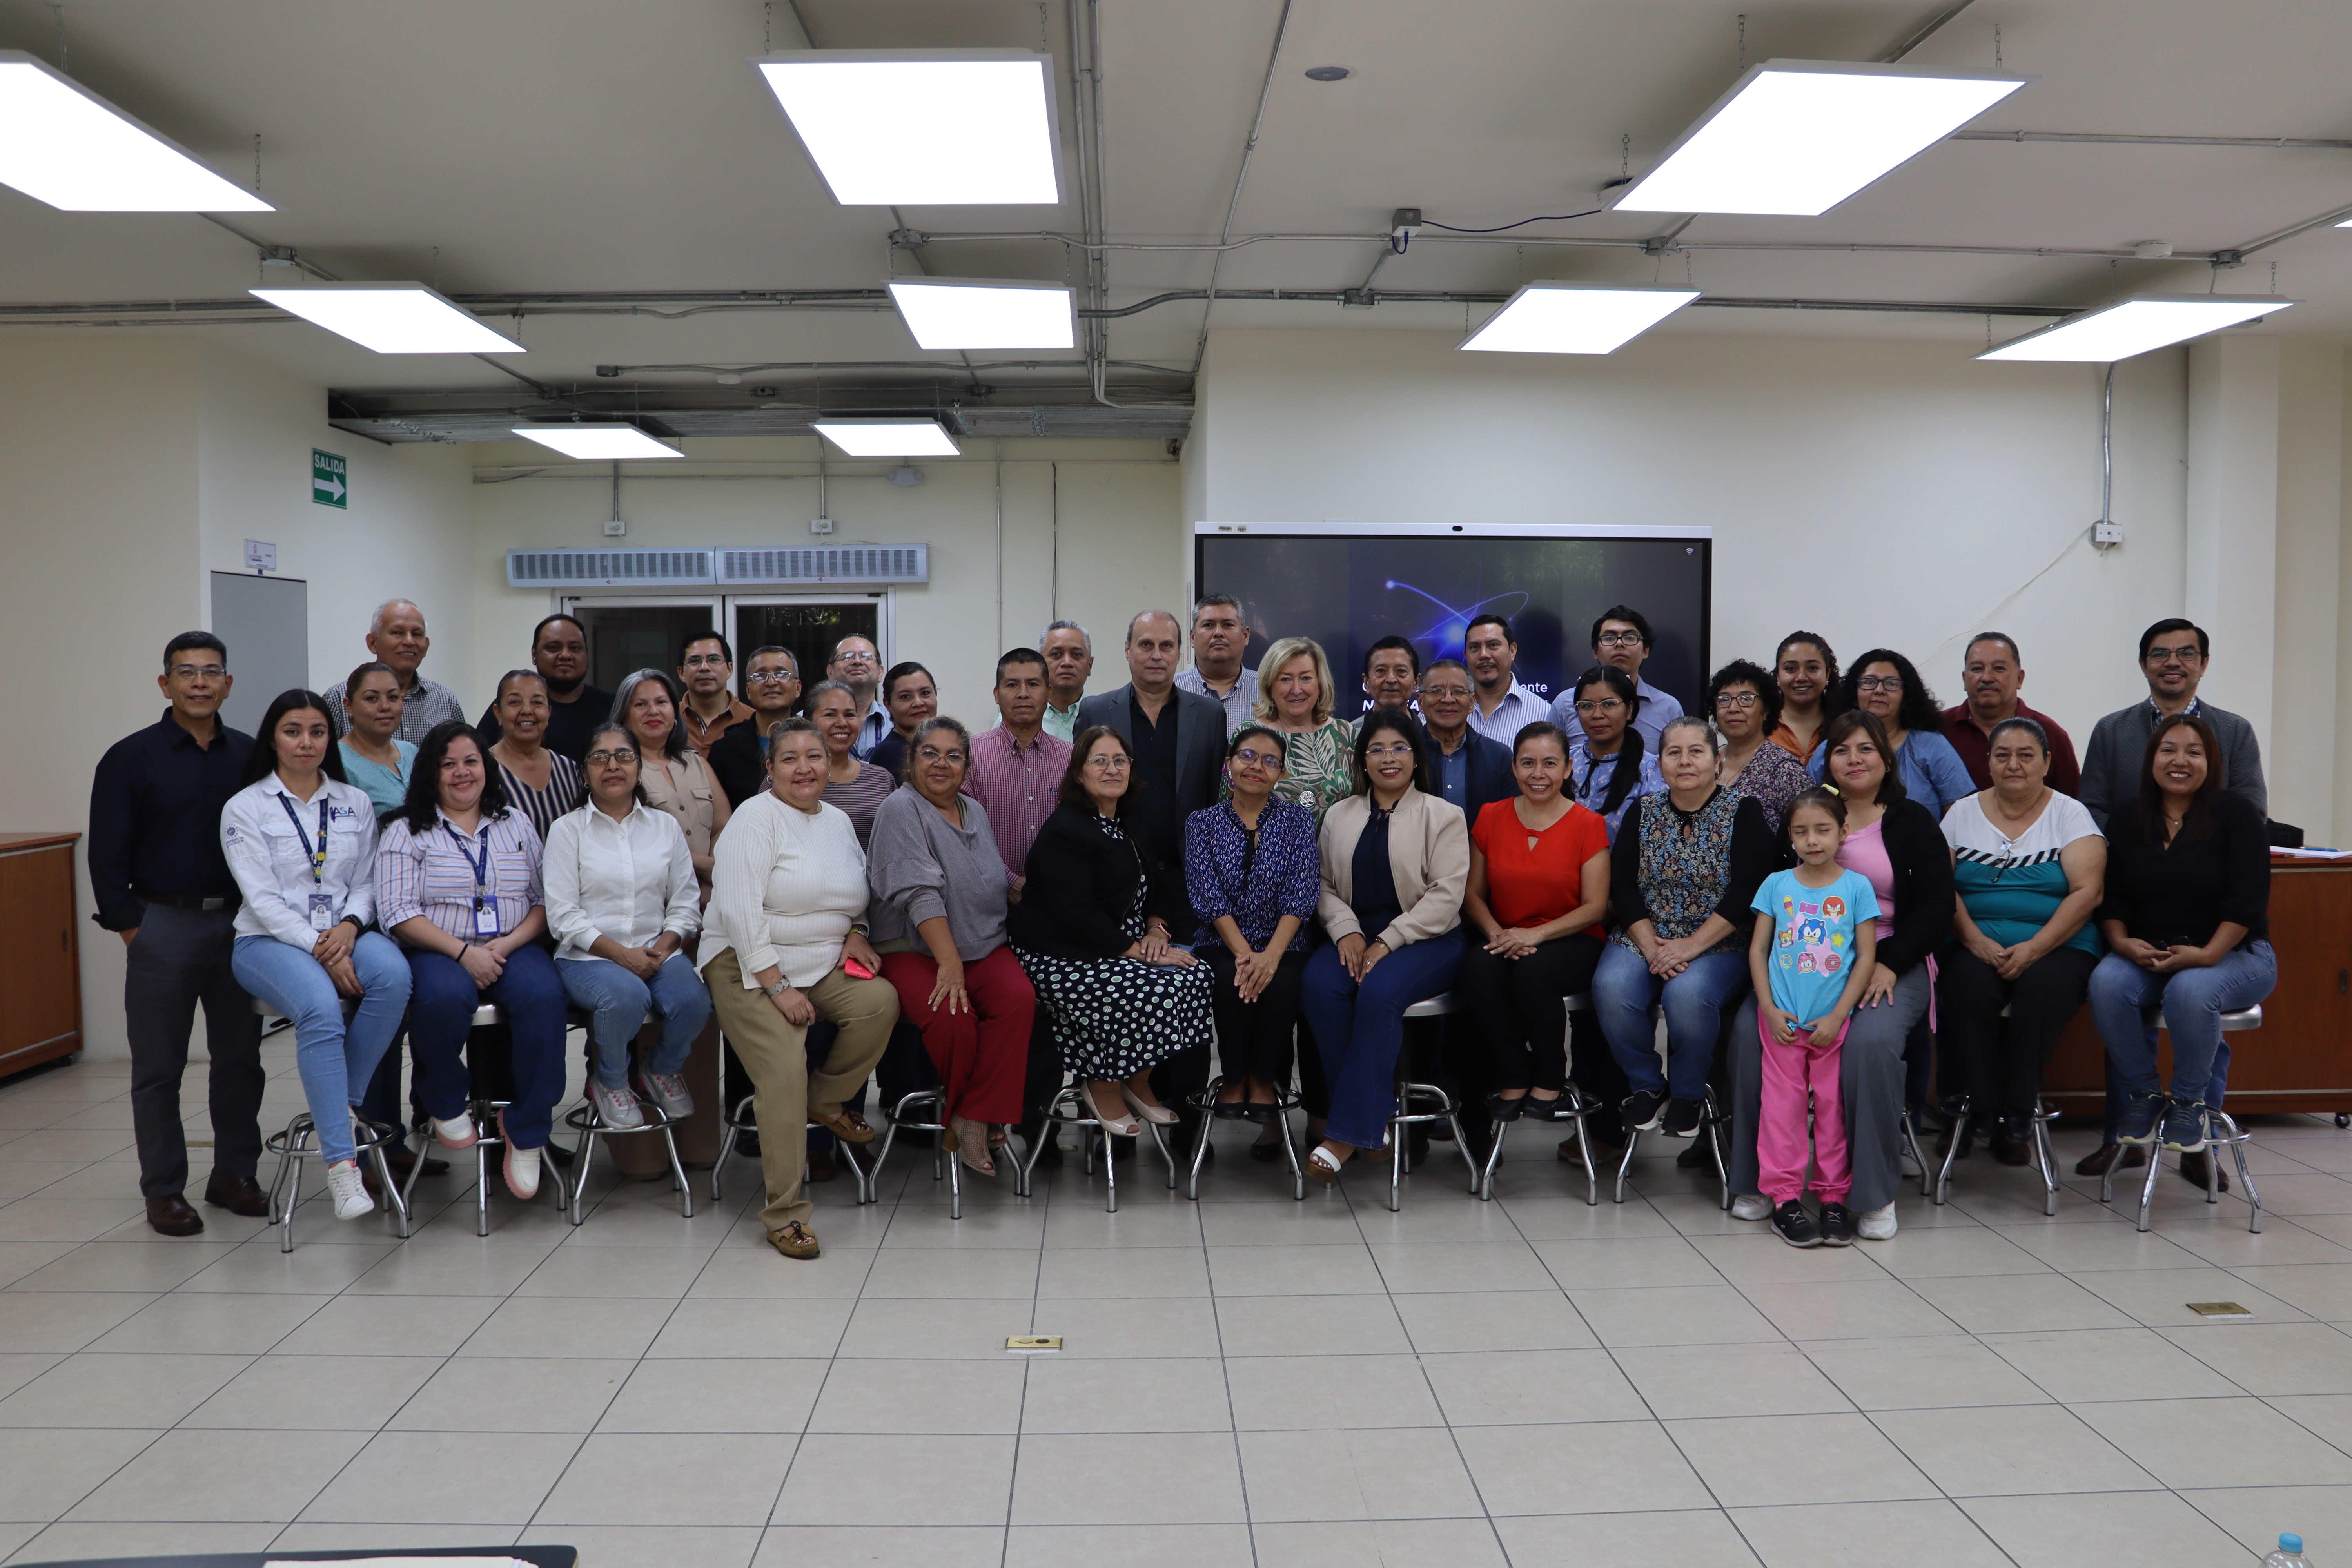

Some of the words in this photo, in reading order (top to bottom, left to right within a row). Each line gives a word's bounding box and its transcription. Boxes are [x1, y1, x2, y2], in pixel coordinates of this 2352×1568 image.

[314, 454, 345, 475] SALIDA
[1521, 682, 1548, 692] ente
[334, 806, 356, 815] ASA
[457, 840, 466, 850] ASA
